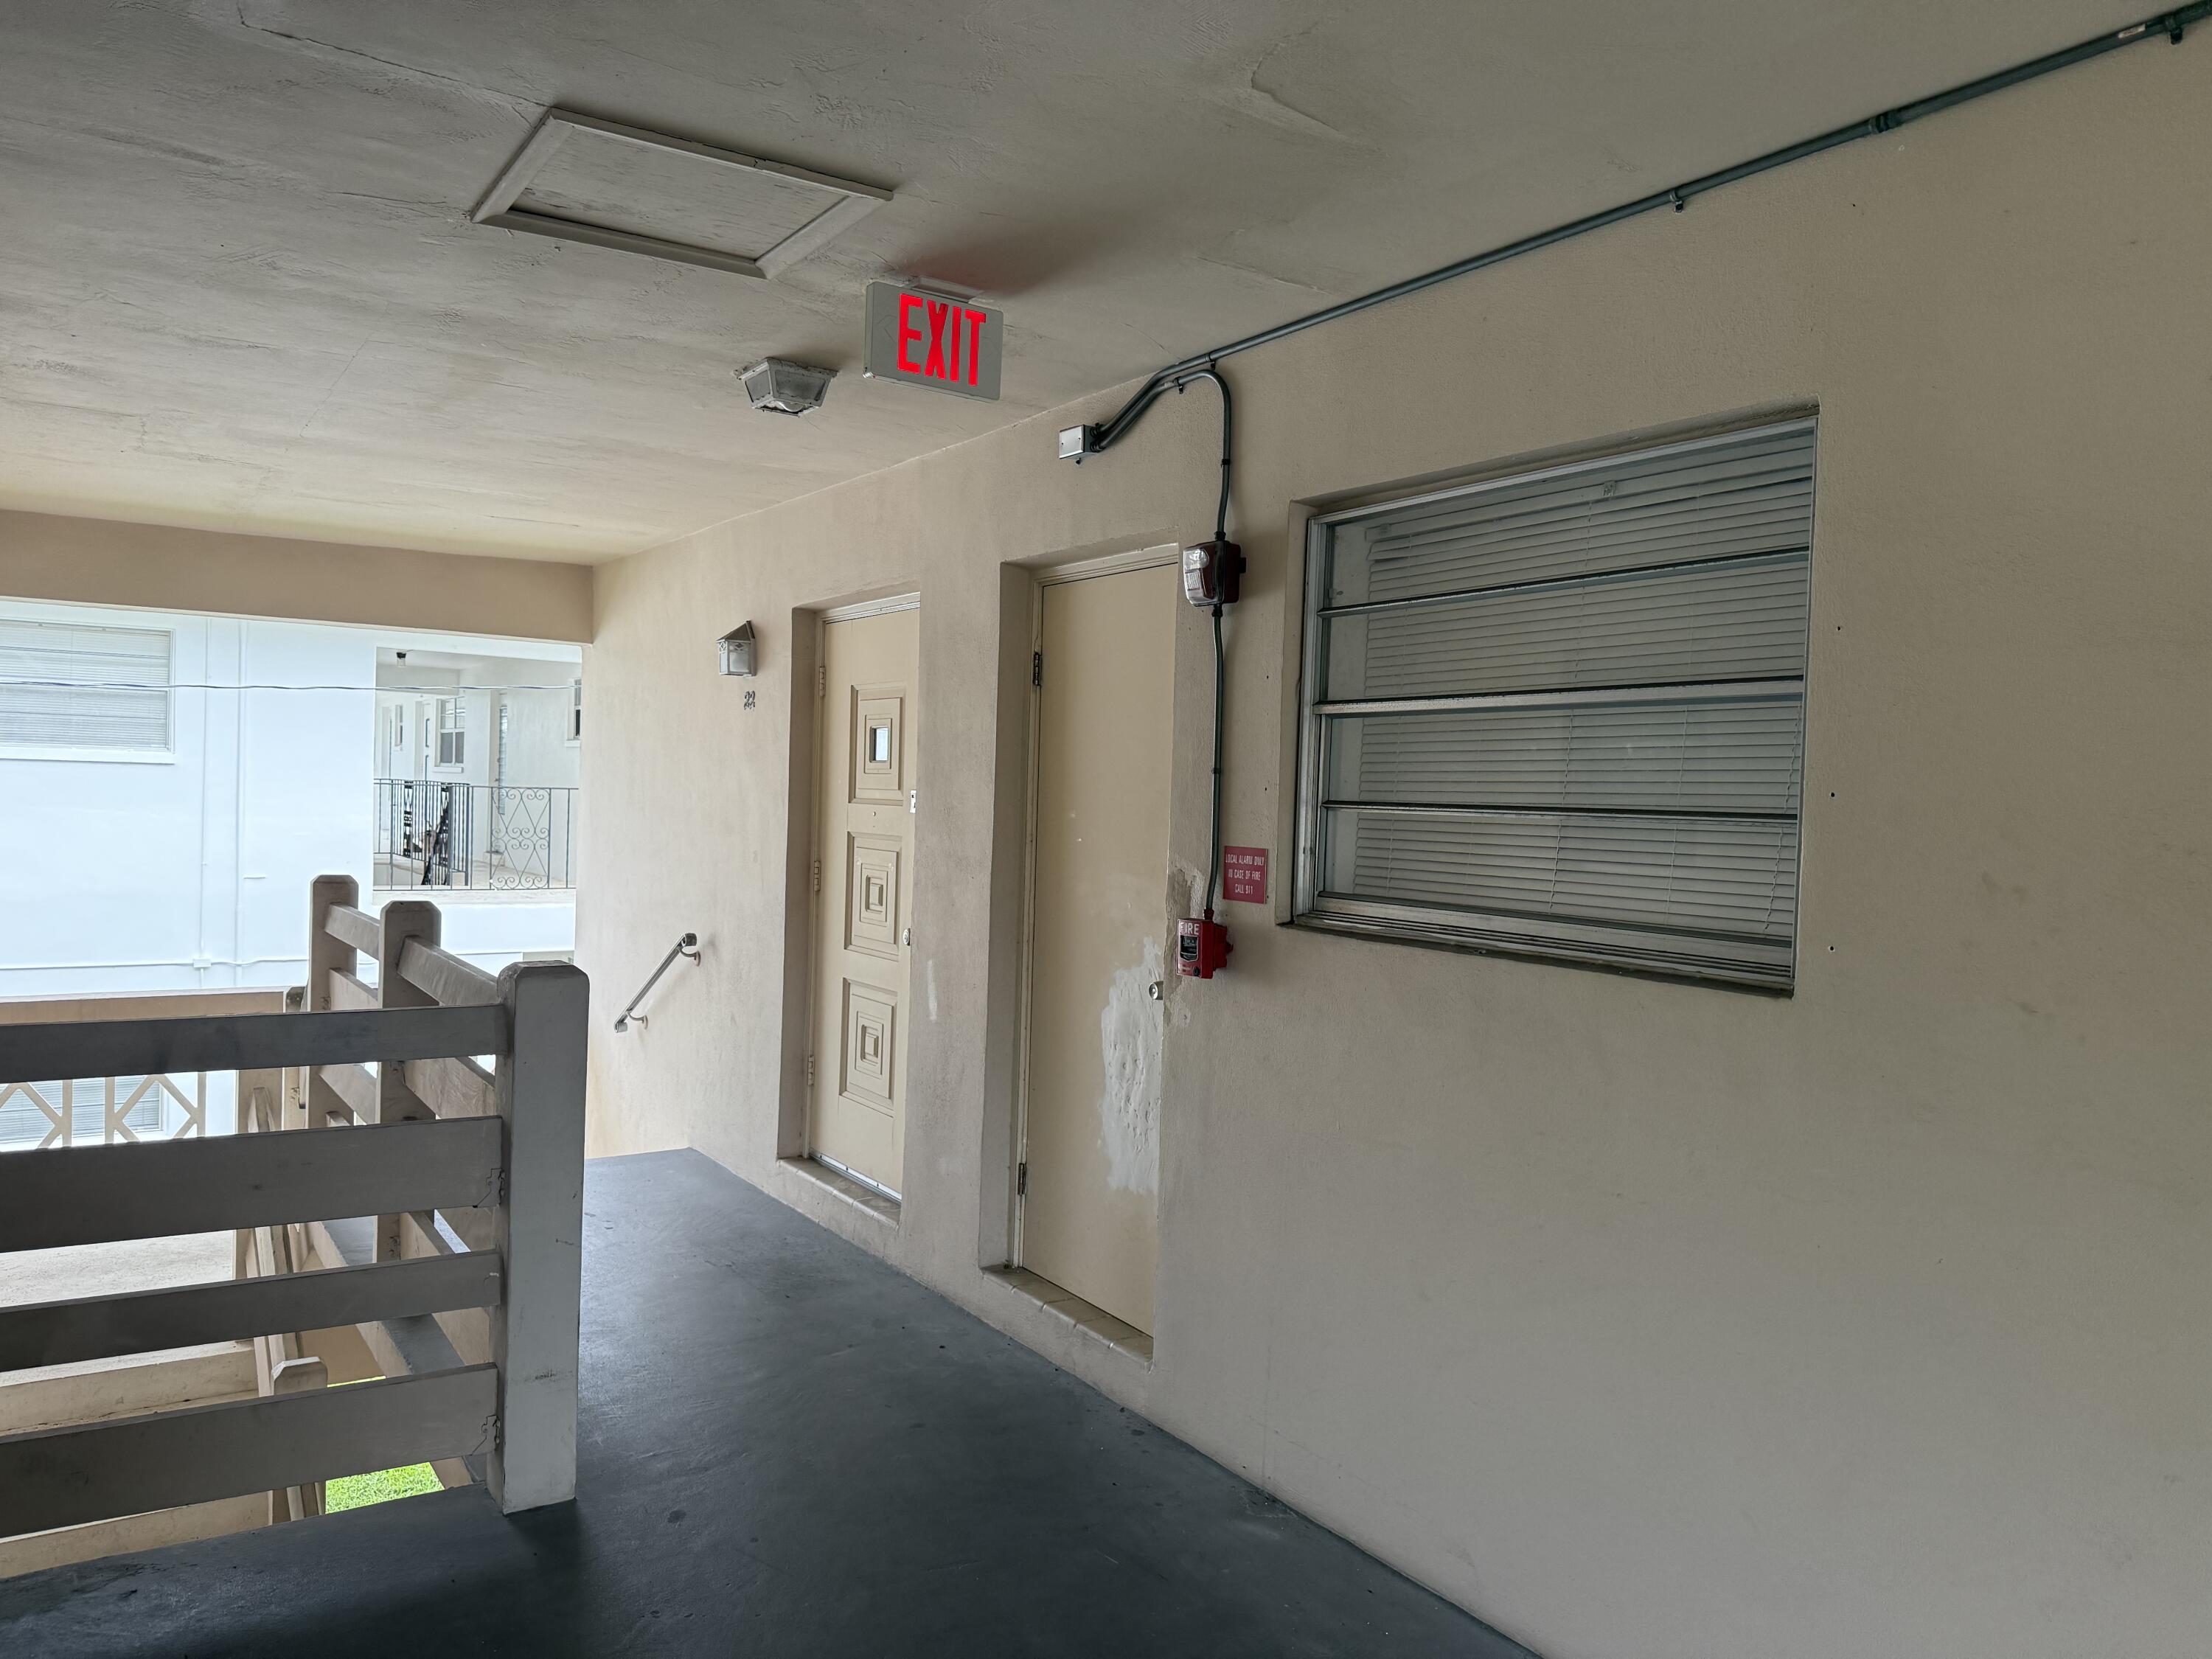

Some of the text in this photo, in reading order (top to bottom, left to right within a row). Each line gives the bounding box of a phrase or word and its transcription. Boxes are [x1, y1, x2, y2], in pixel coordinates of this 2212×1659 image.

[897, 293, 987, 386] EXIT
[1225, 854, 1265, 866] LOCAL ALARM ONLY
[1228, 869, 1261, 881] IN CASE OF FIRE
[1235, 883, 1245, 894] CALL
[1180, 922, 1200, 935] FIRE
